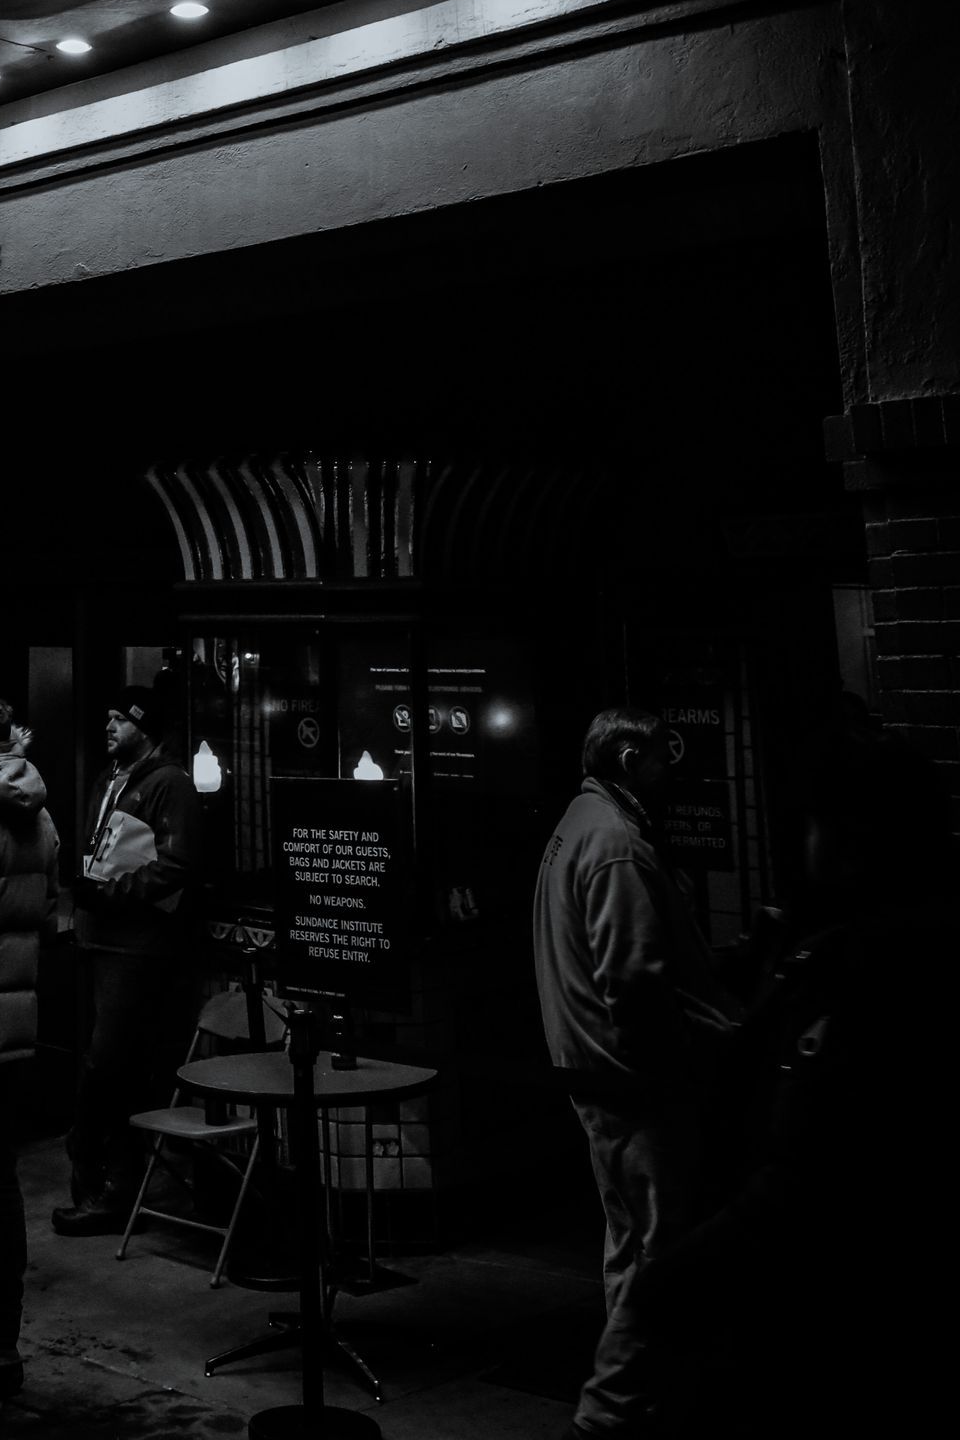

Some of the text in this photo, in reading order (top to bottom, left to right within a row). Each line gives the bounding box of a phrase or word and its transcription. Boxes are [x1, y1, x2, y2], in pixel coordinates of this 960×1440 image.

[292, 828, 379, 843] FOR THE SAFETY AND
[283, 842, 391, 860] COMFORT OF OUR GUESTS,
[289, 856, 386, 873] BAGS AND JACKETS ARE
[295, 871, 381, 887] SUBJECT TO SEARCH.
[310, 894, 367, 909] NO WEAPONS.
[295, 916, 384, 934] SUNDANCE INSTITUTE
[289, 929, 391, 950] RESERVES THE RIGHT TO
[308, 946, 371, 963] REFUSE ENTRY.
